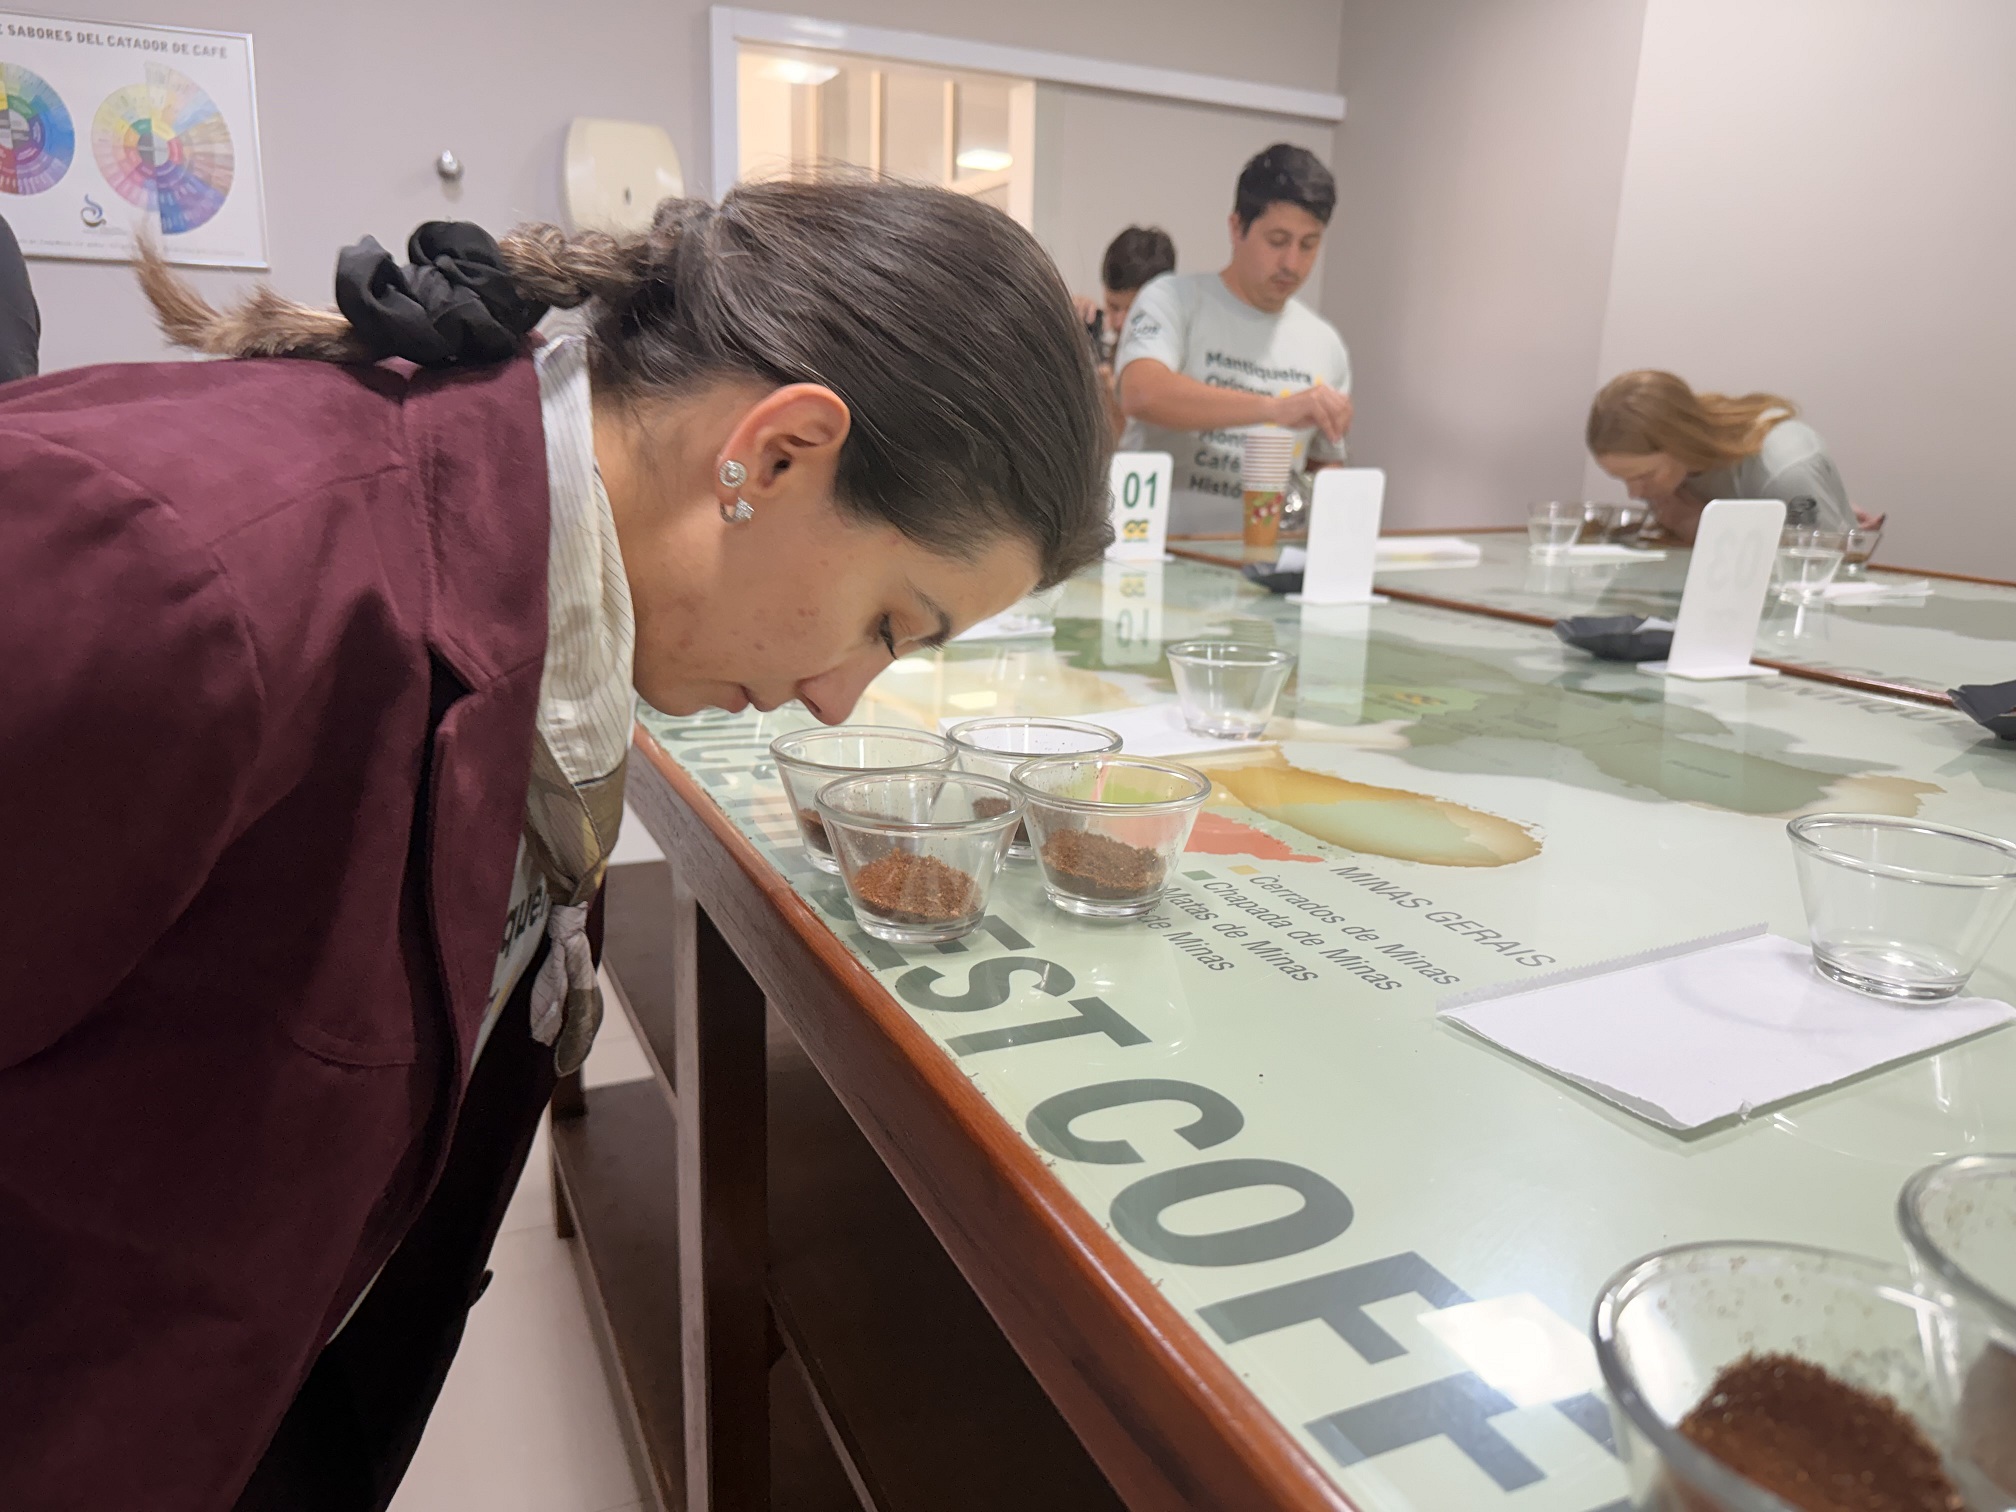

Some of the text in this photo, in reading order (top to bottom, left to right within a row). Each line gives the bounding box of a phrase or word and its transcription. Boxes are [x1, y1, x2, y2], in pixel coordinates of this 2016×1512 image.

[7, 24, 73, 42] SABORES
[77, 30, 104, 46] DEL
[107, 35, 168, 53] CATADOR
[172, 42, 189, 56] DE
[1205, 351, 1312, 385] Mantiqueira
[1194, 449, 1241, 473] Café
[1123, 471, 1158, 509] 01
[1136, 915, 1235, 971] de Minas
[1164, 887, 1319, 982] Matas de Minas
[1202, 881, 1403, 991] Chapada de Minas
[1249, 875, 1461, 986] Cerrados de Minas
[1329, 866, 1557, 968] MINAS GERAIS
